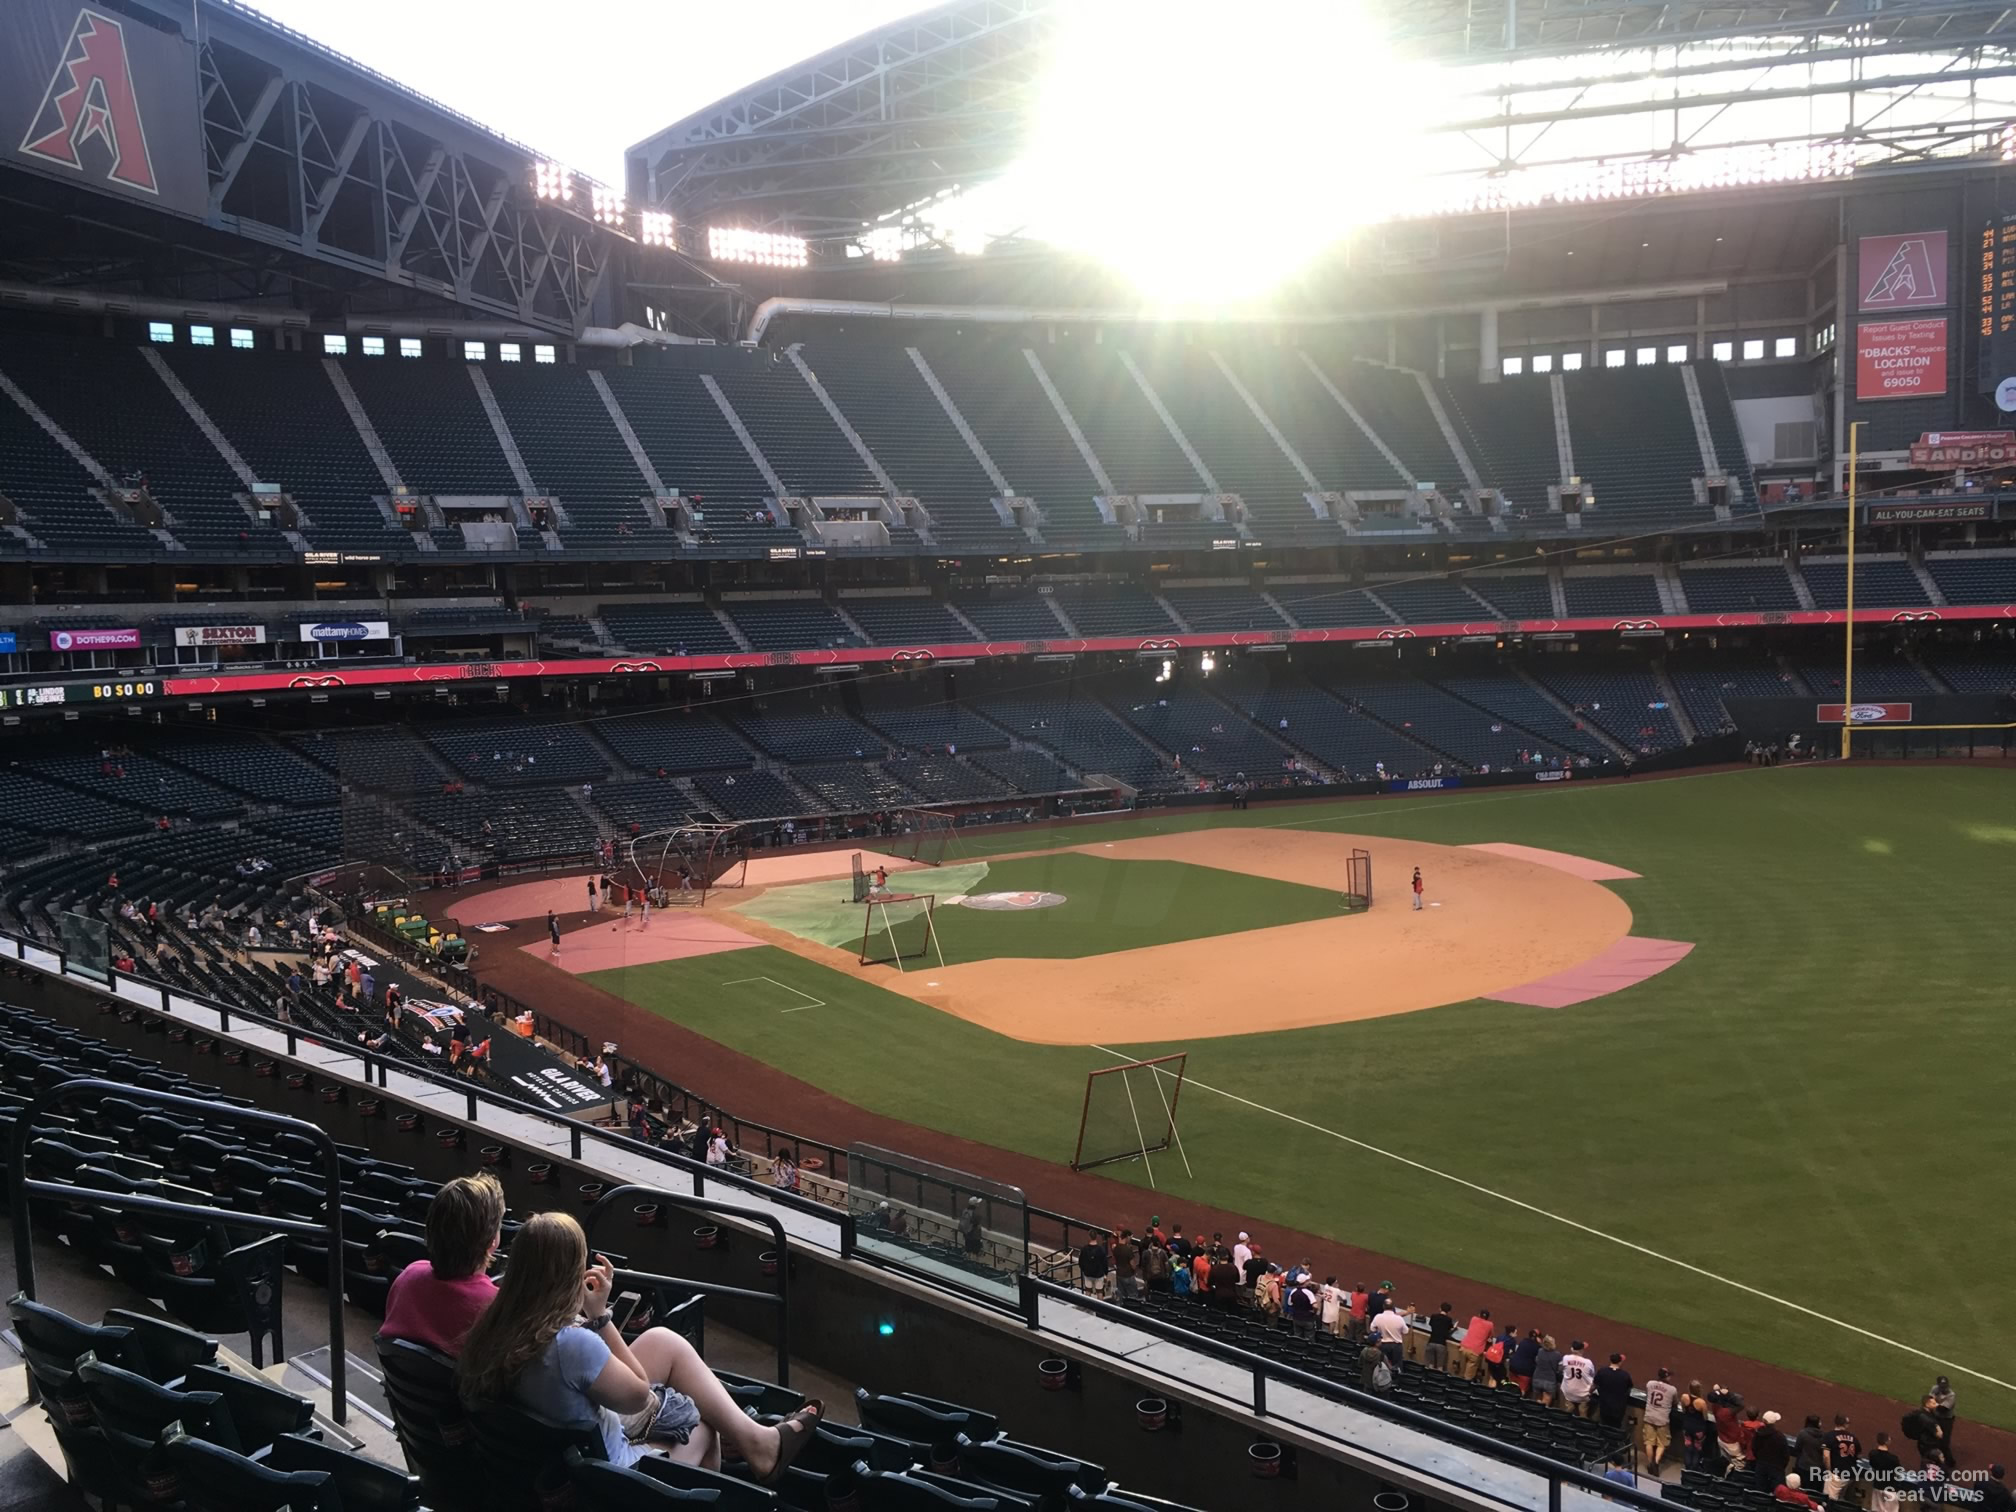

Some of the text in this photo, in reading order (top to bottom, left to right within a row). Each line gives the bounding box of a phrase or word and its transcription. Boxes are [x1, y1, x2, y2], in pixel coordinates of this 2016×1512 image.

[1863, 321, 1944, 334] Report Guest Conduct
[1872, 331, 1936, 342] Issues by Texting
[1874, 356, 1931, 369] LOCATION
[1883, 376, 1921, 388] 69050
[1876, 507, 1985, 520] ALL-YOU-CAN-EAT SEATS
[202, 627, 256, 639] SEXTON
[76, 635, 136, 645] DOTHE99.COM
[526, 1072, 549, 1086] HOTELS
[552, 1088, 580, 1105] CASINOS
[540, 1068, 601, 1101] GILA RIVER
[1571, 1367, 1583, 1380] 13
[1650, 1391, 1664, 1406] 12
